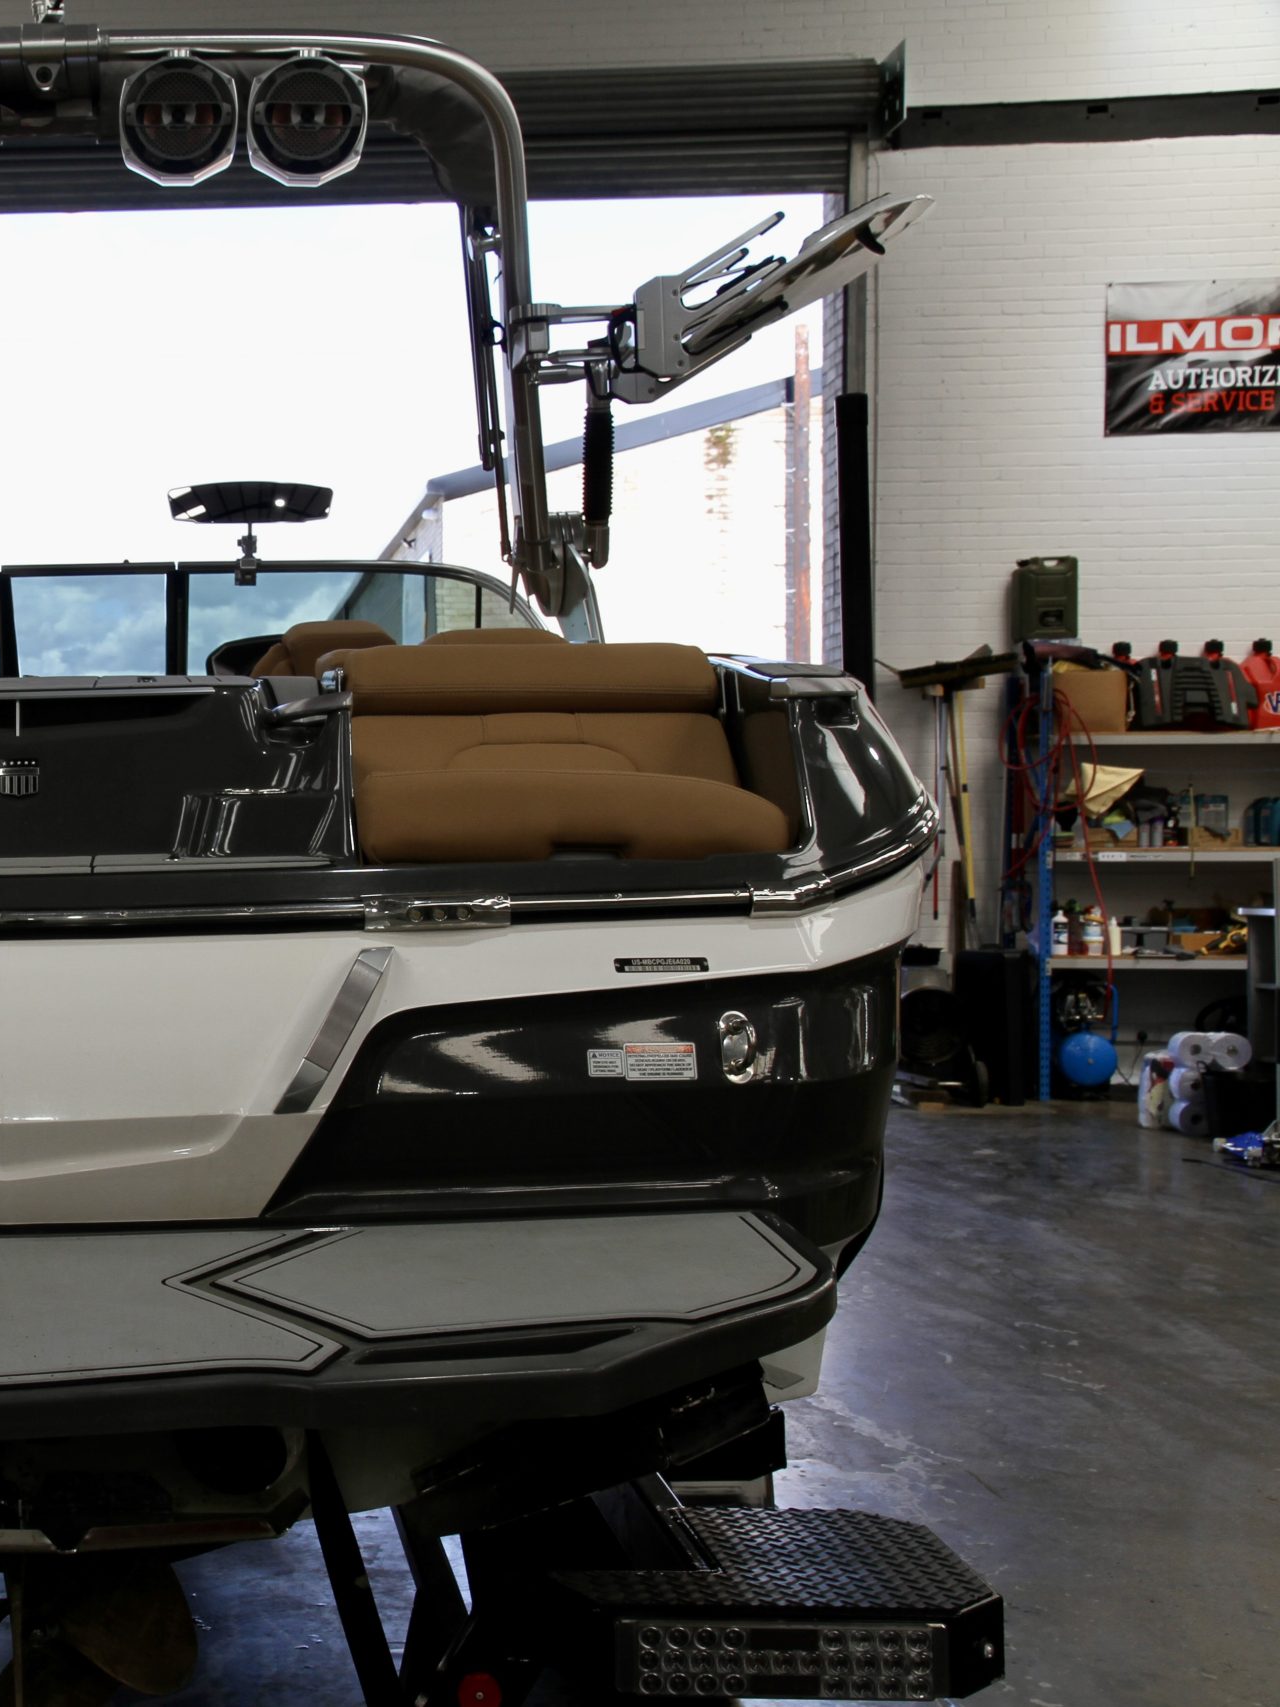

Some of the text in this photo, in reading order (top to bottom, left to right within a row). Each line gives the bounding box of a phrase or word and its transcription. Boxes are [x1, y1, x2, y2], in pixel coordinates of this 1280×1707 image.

[1109, 318, 1280, 352] ILMO
[1148, 365, 1280, 391] AUTHORIZ
[1148, 390, 1275, 415] & SERVICE
